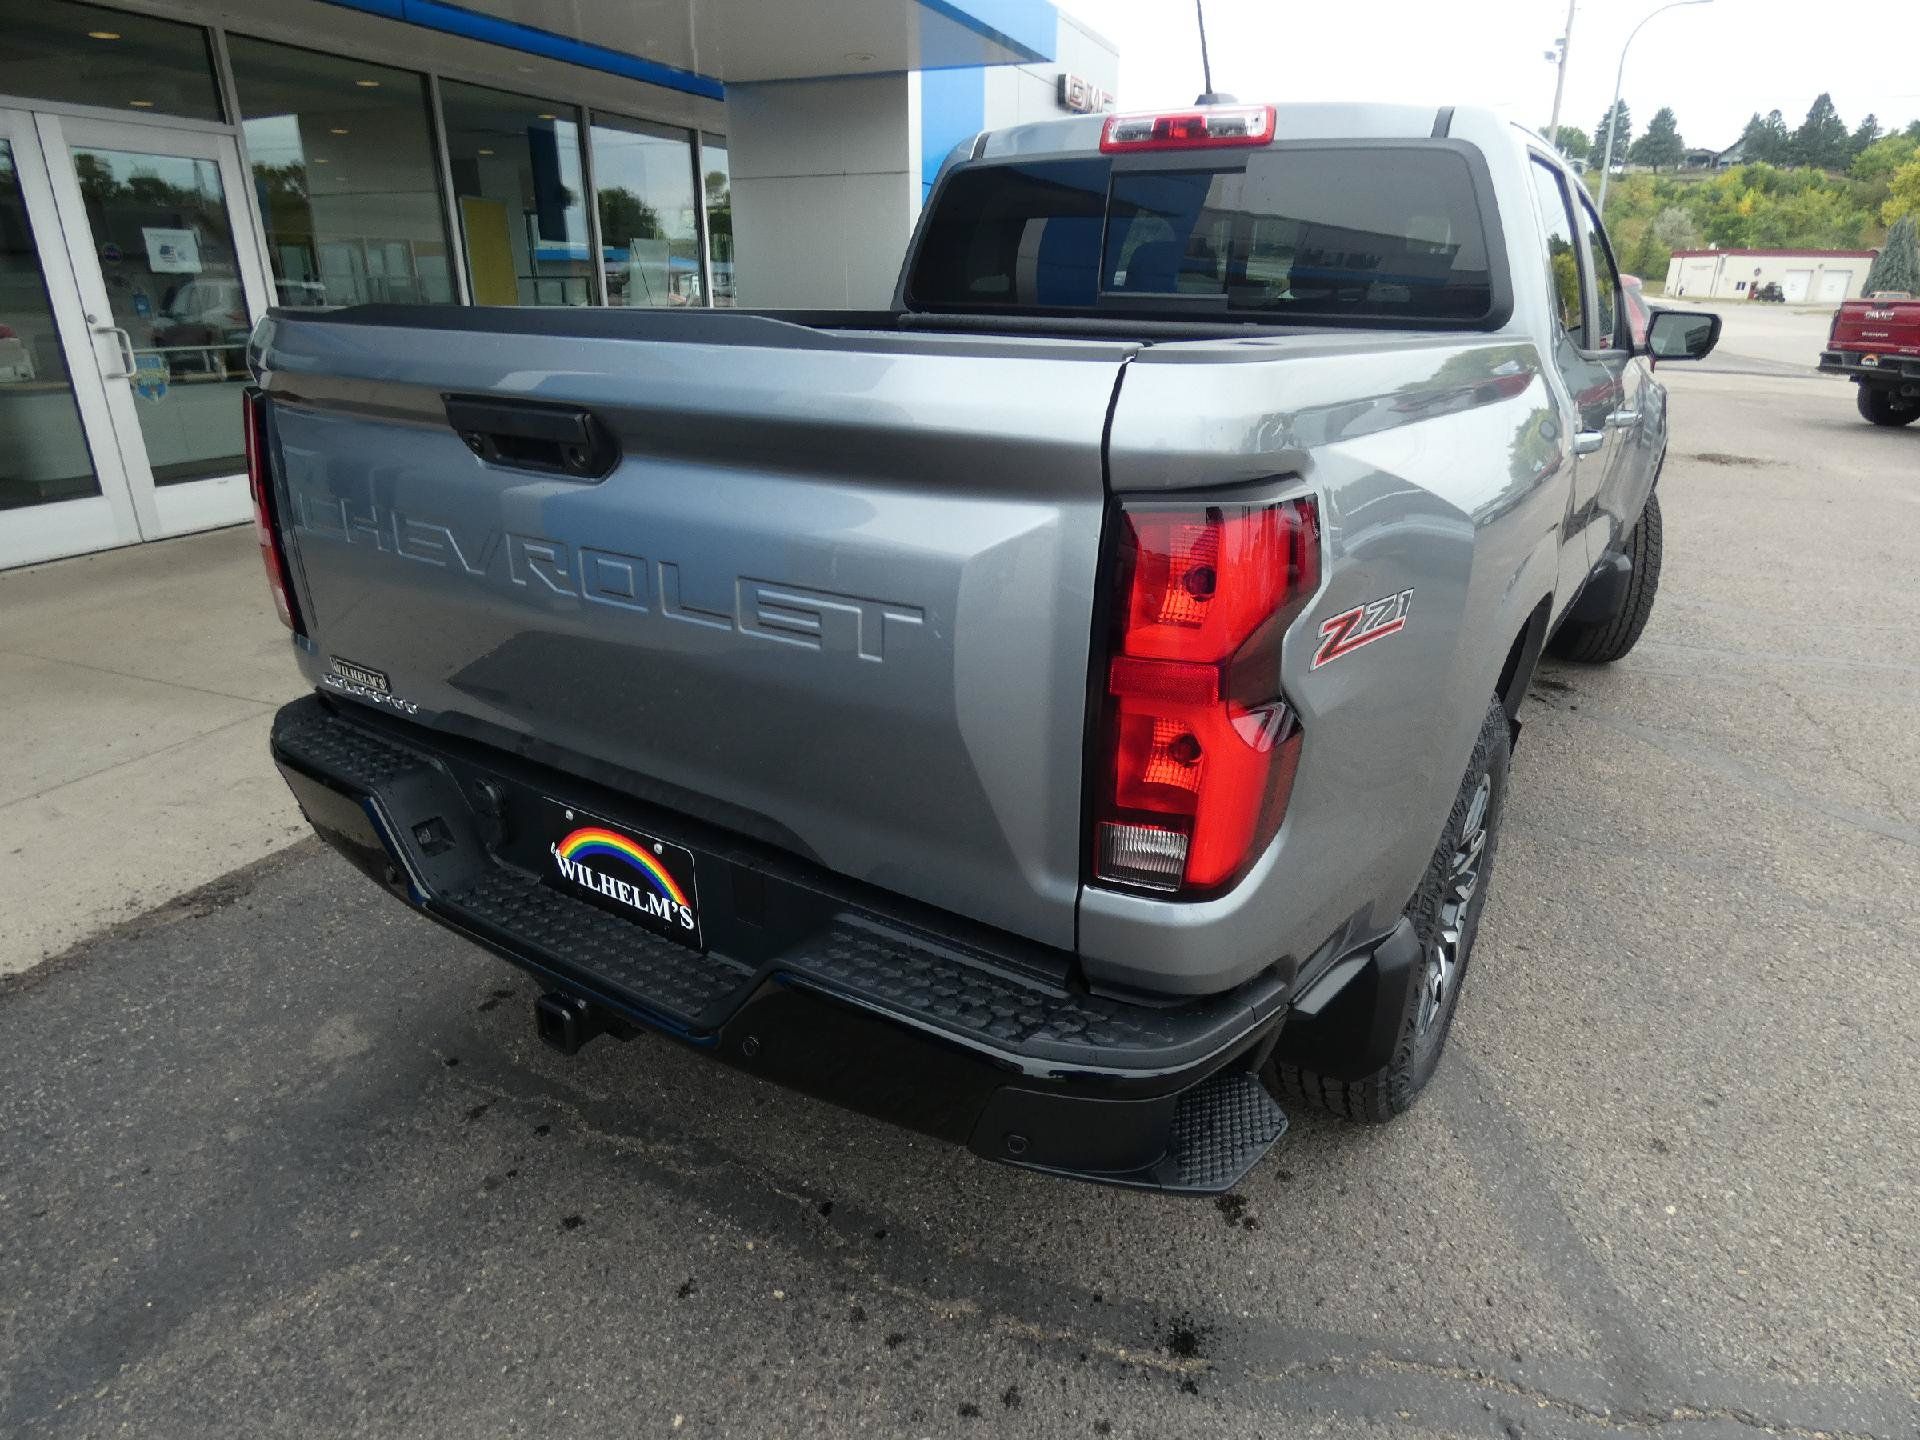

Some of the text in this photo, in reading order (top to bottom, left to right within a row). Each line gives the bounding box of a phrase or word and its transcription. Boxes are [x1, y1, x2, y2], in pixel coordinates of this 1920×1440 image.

[298, 490, 925, 664] CHEVROLET
[1308, 588, 1414, 672] Z71
[331, 660, 387, 690] WILHELM'S
[554, 849, 695, 931] WILHELM'S
